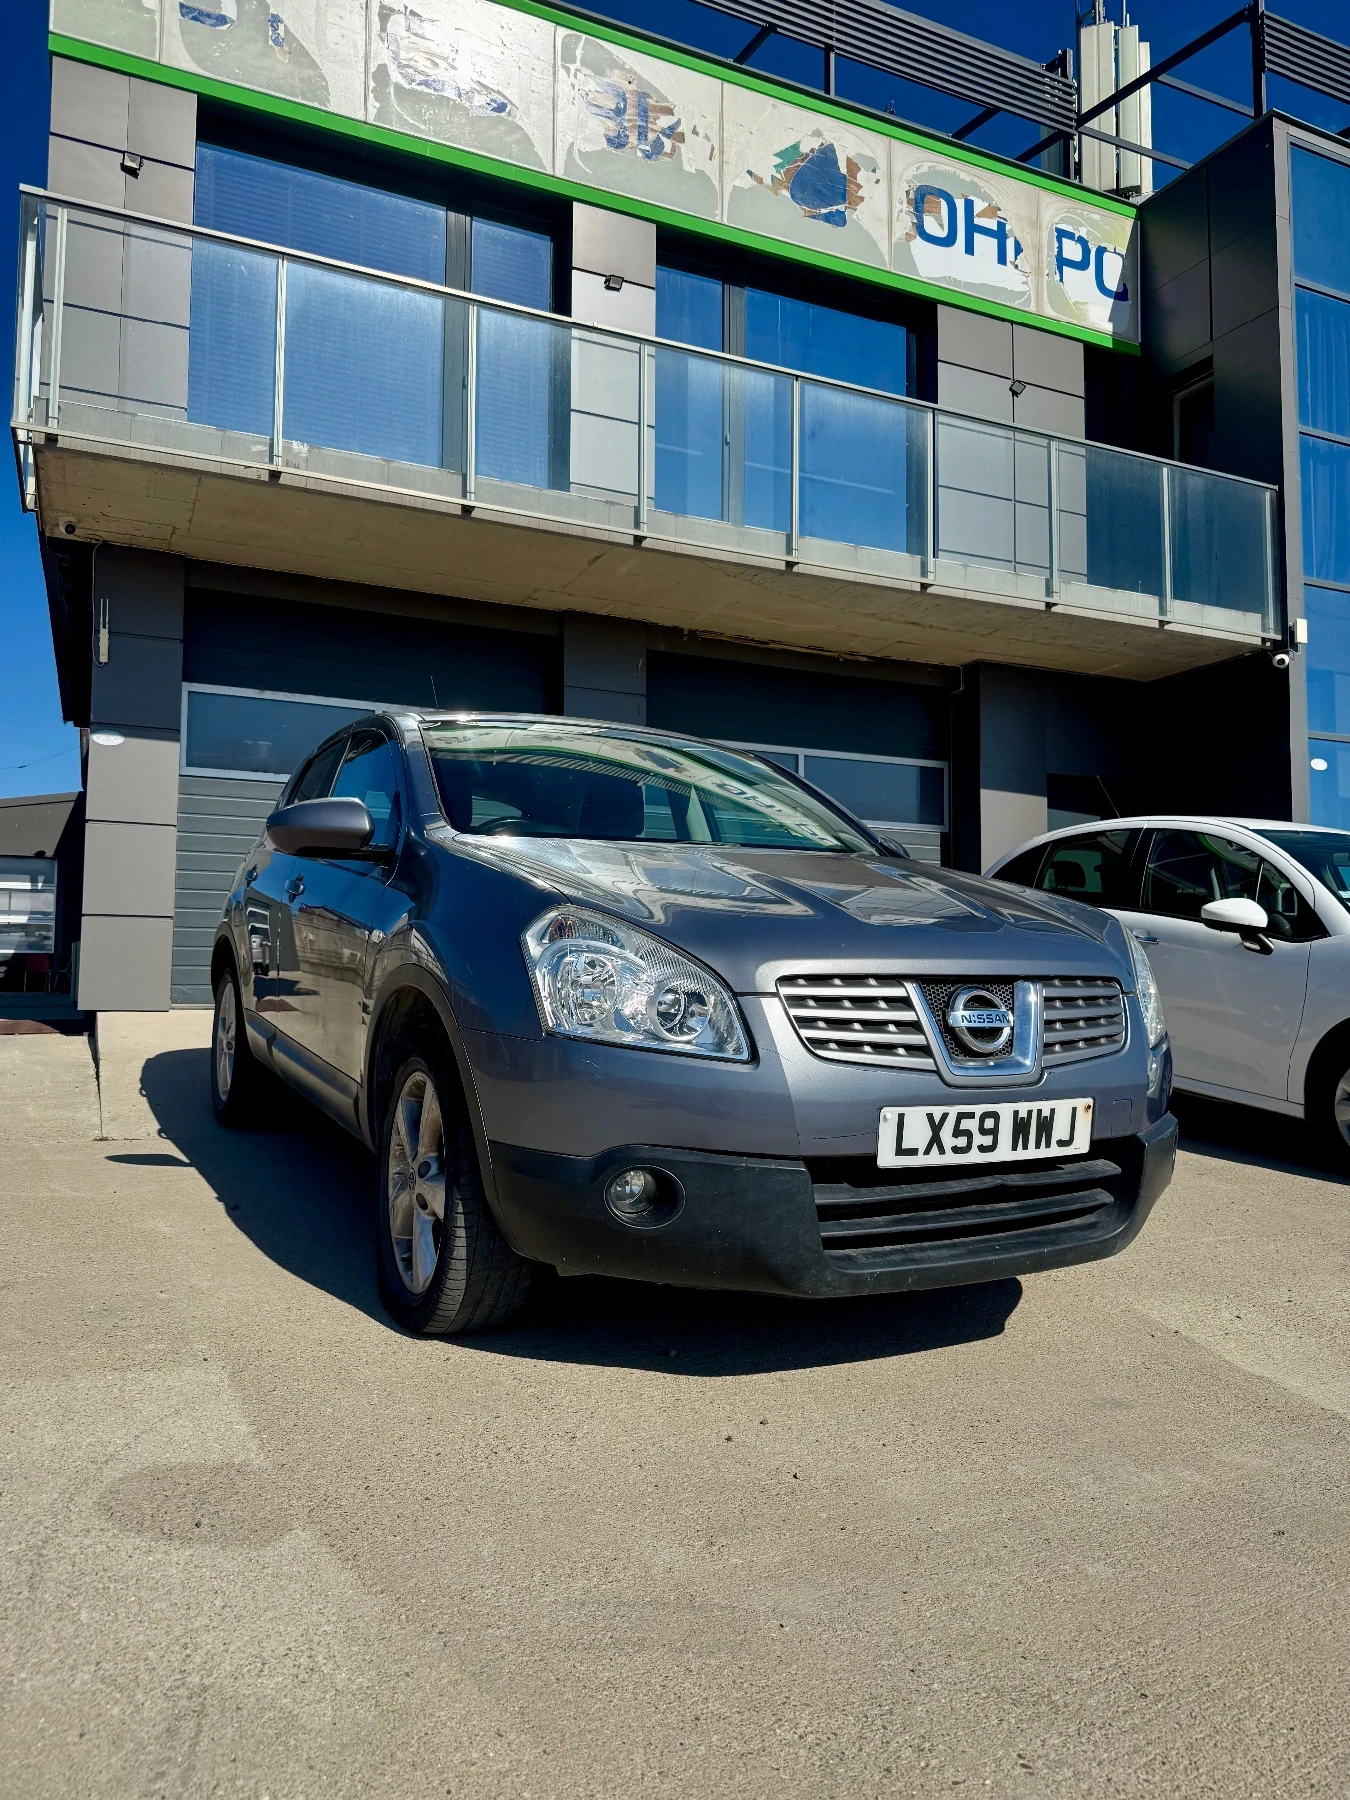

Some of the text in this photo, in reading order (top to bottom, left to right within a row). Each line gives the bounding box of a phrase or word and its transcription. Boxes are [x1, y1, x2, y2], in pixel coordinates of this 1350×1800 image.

[961, 1013, 1010, 1024] NISSAN
[894, 1106, 1078, 1157] LX59 WWJ
